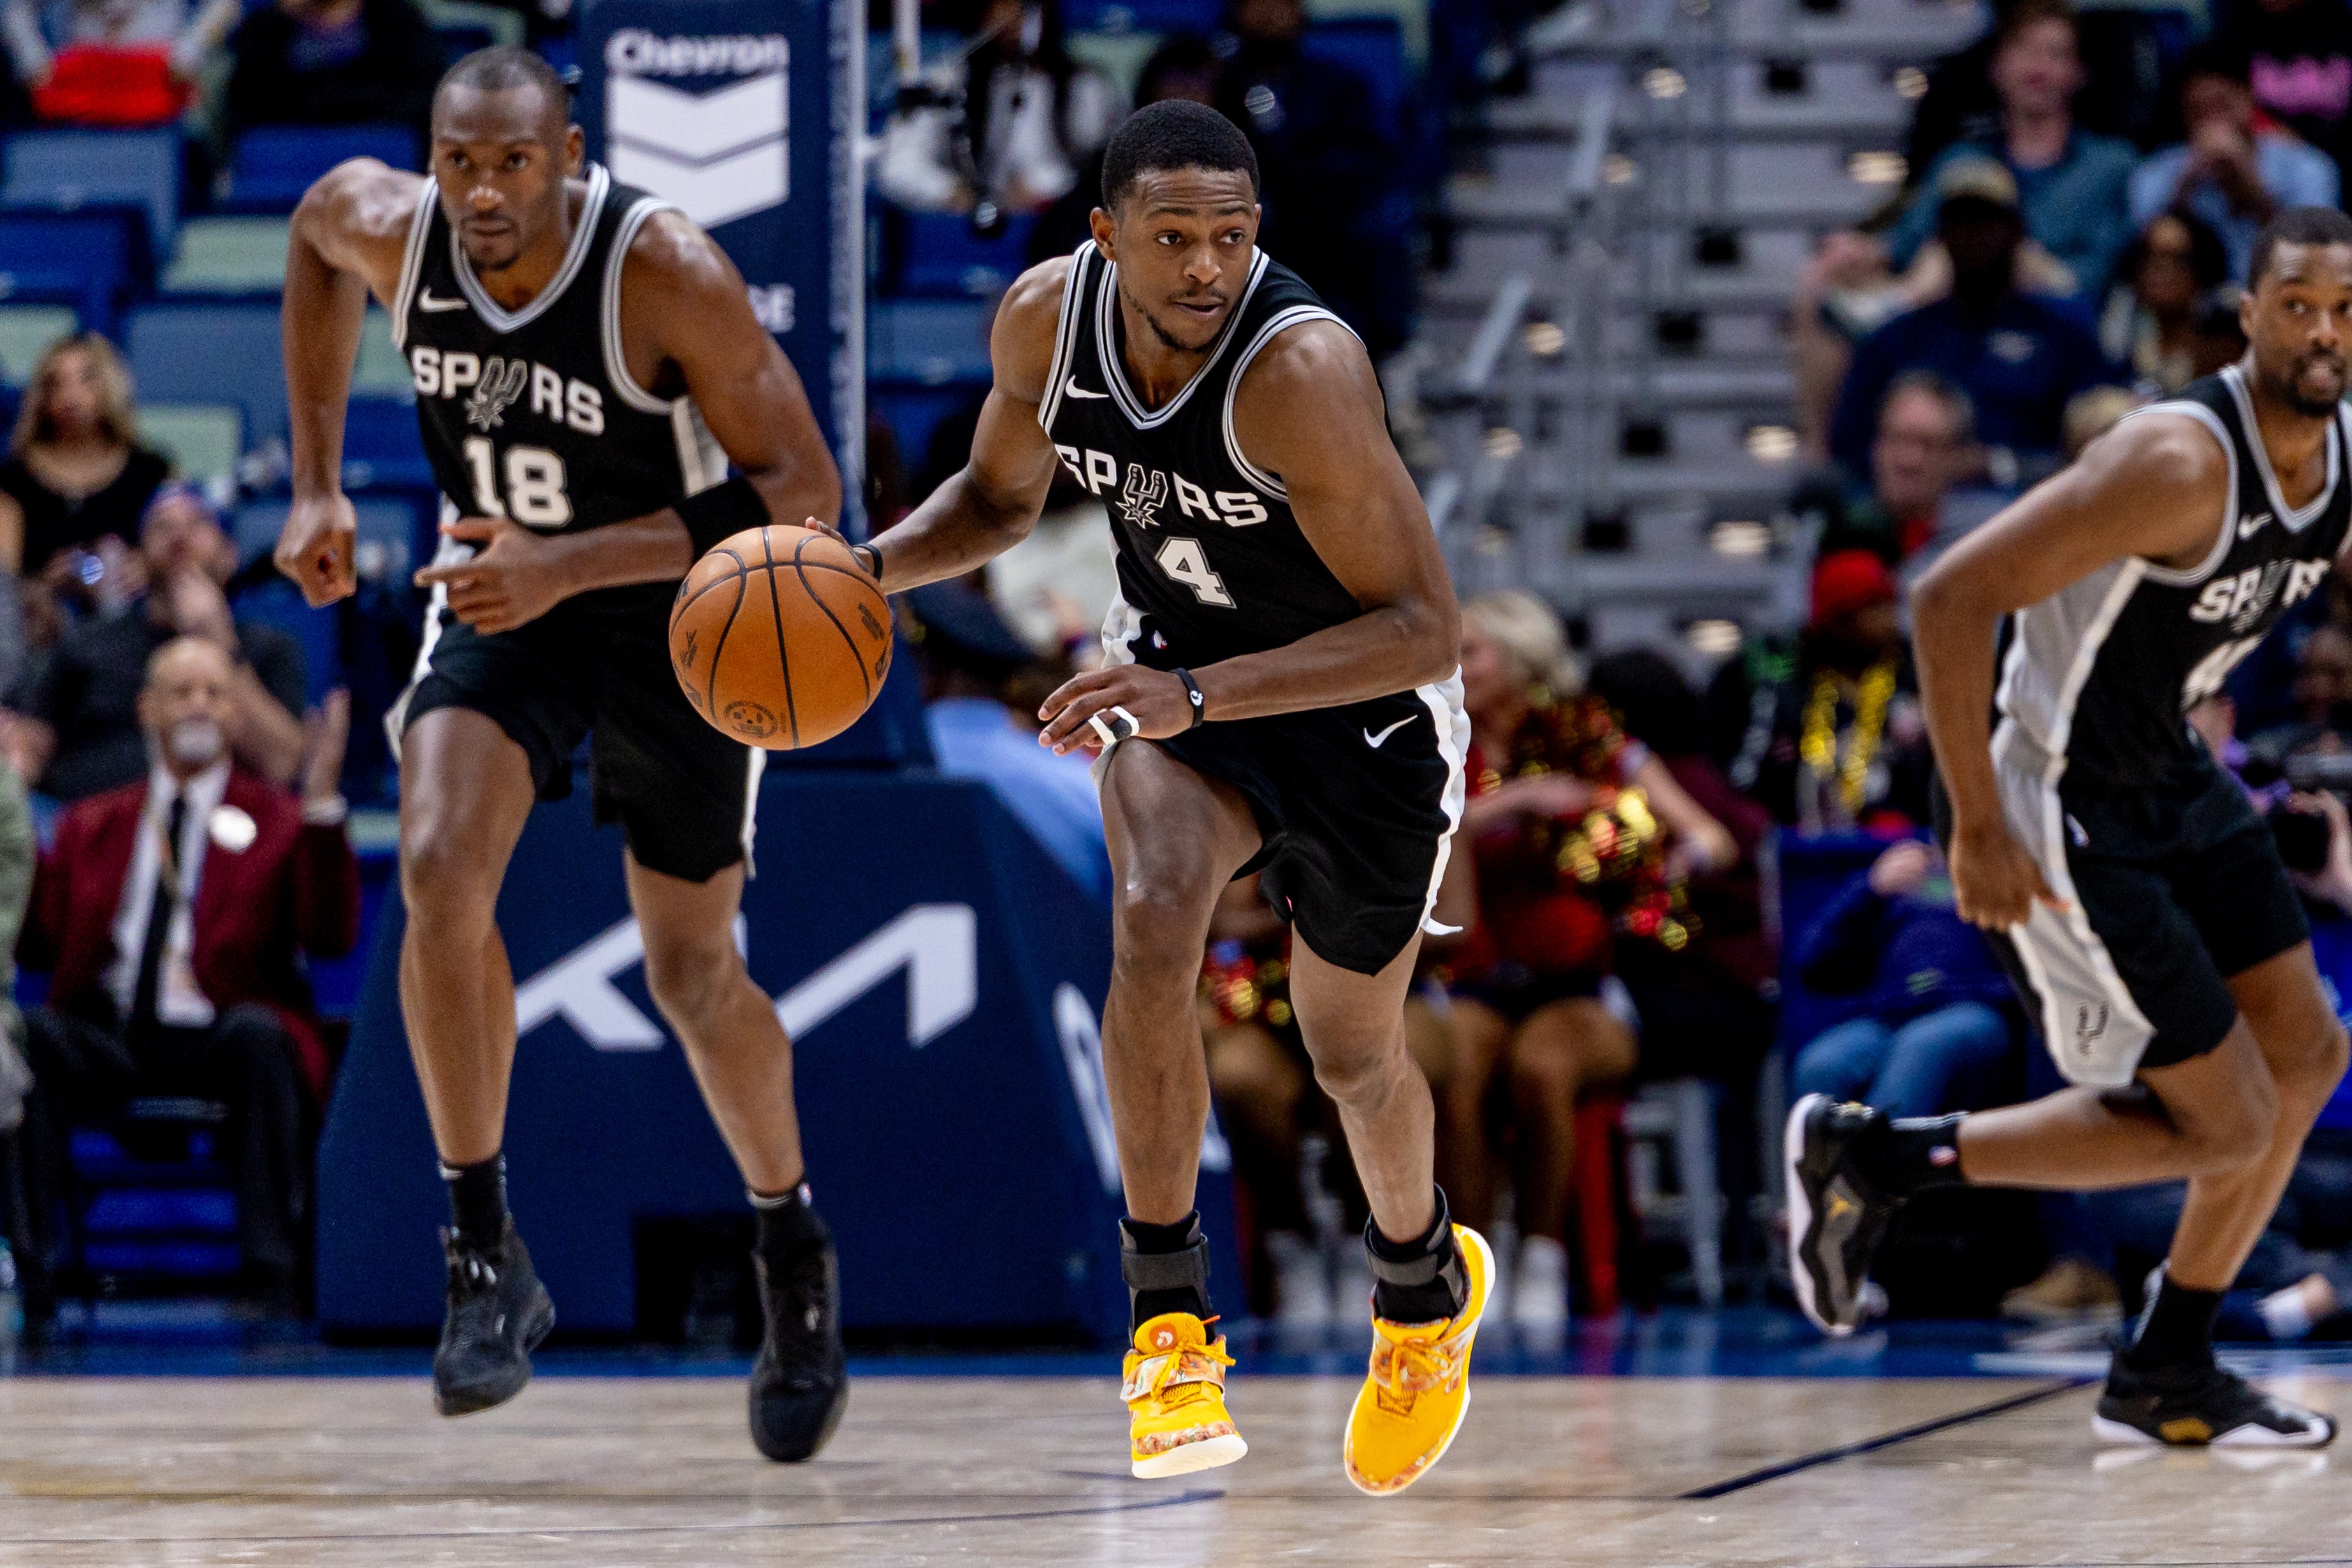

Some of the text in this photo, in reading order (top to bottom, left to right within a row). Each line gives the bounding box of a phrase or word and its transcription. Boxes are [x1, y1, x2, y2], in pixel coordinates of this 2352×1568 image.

[604, 28, 790, 76] Chevron
[411, 345, 606, 436] SPURS
[463, 435, 574, 528] 18
[1154, 536, 1237, 609] 4
